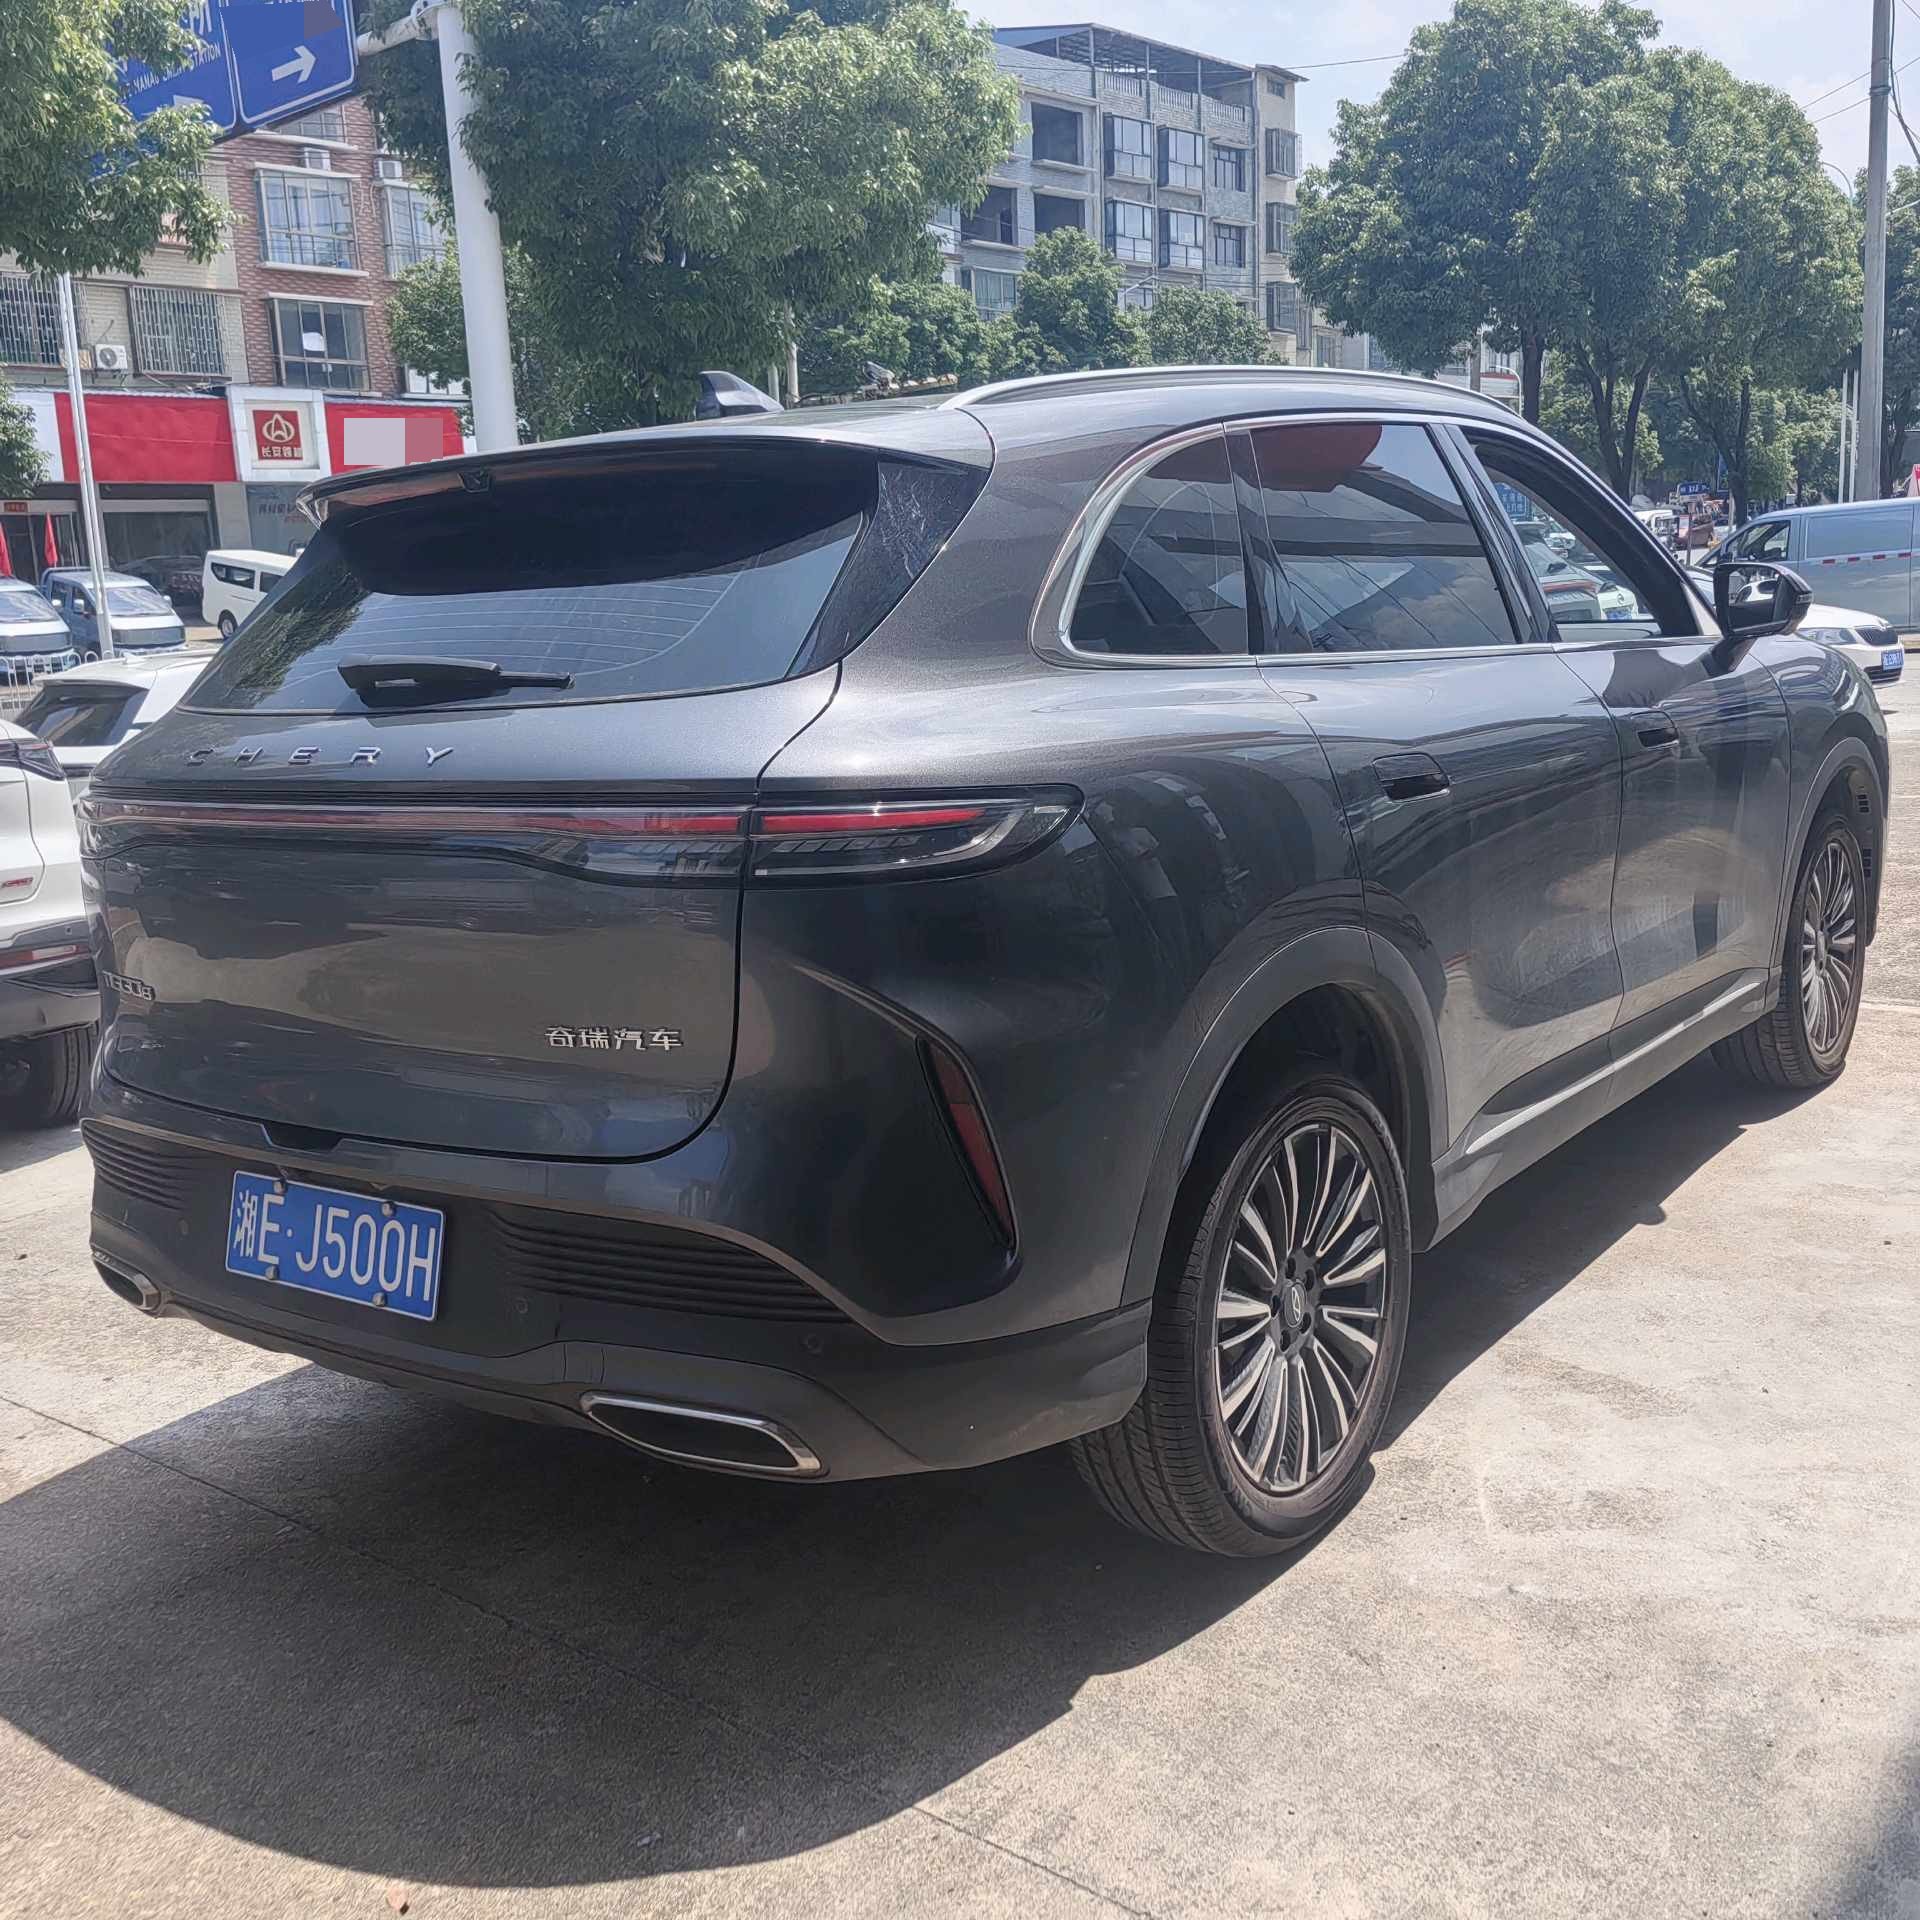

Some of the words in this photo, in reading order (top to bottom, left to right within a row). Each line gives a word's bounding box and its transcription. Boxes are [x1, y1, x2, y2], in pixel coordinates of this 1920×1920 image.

[186, 746, 454, 767] CHERY
[544, 1026, 682, 1051] 奇瑞汽车
